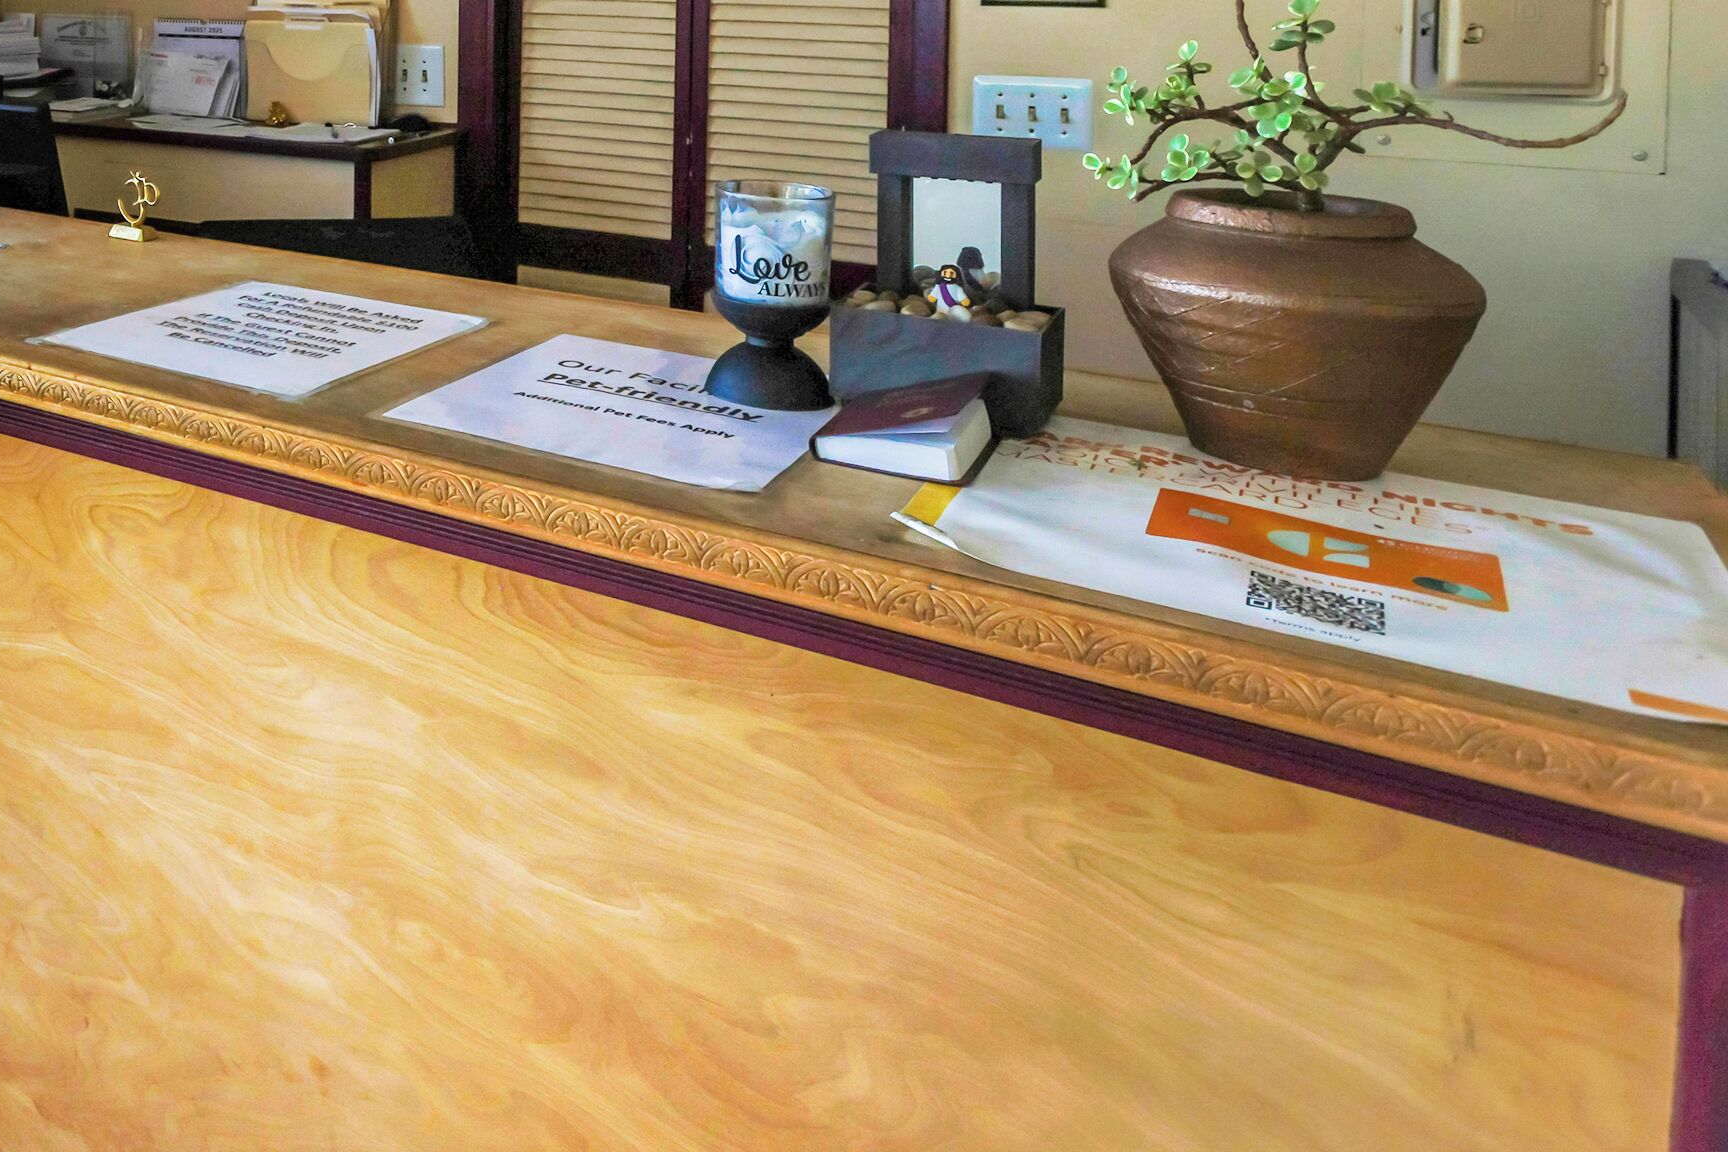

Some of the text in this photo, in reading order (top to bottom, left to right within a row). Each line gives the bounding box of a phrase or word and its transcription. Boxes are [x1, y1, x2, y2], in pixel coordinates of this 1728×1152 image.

[729, 235, 811, 284] Love
[157, 321, 187, 329] The
[314, 301, 346, 309] Will
[371, 312, 423, 324] Asked
[214, 316, 242, 324] The
[296, 332, 356, 347] Cannot
[342, 322, 386, 333] Upon
[194, 337, 276, 357] Cancelled
[558, 359, 622, 375] Our
[542, 373, 764, 422] Pet-friendly
[514, 391, 735, 439] Additional Pet Fees Apply
[1382, 491, 1594, 536] NIGHTS
[1196, 548, 1242, 561] scan
[1304, 576, 1323, 585] to
[1331, 582, 1383, 596] learn
[1391, 594, 1448, 610] more
[1321, 629, 1360, 642] apply
